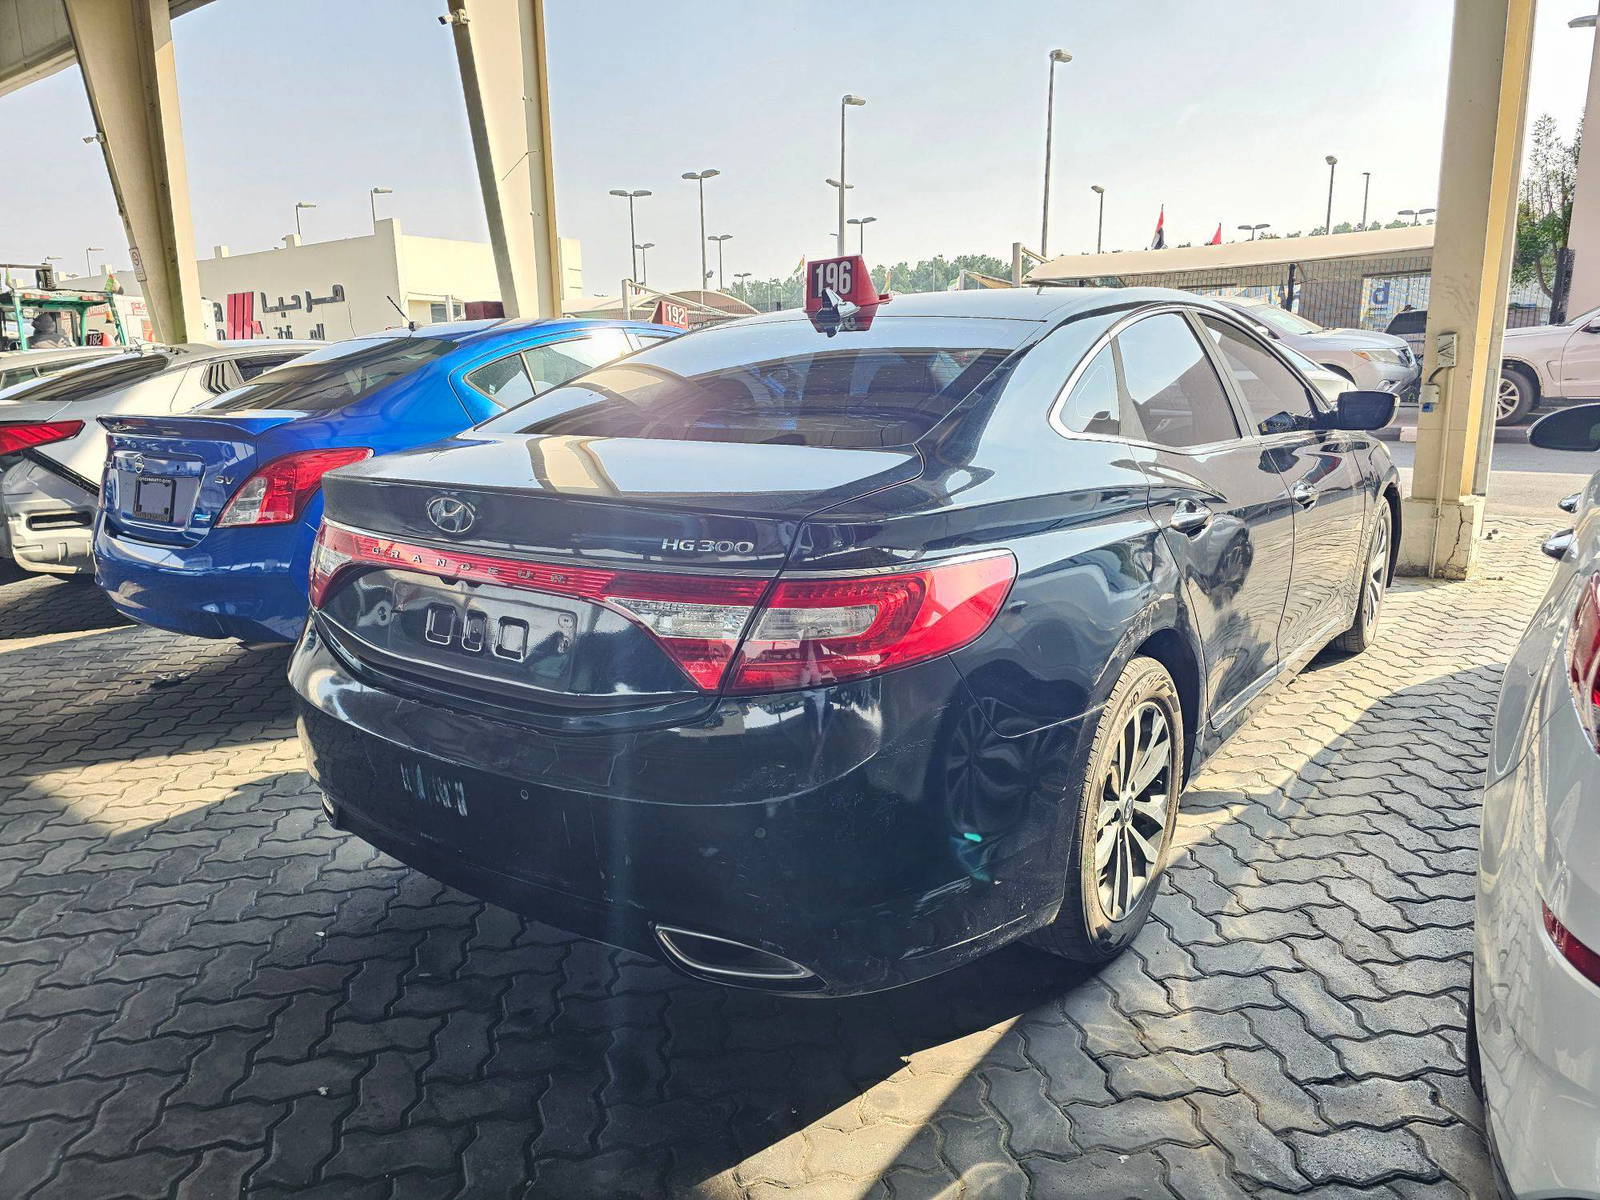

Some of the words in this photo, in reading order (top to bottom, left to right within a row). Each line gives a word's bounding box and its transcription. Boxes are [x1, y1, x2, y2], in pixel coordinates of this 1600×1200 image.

[815, 260, 852, 298] 196
[260, 284, 345, 318] مرحبا
[667, 304, 686, 325] 192
[88, 333, 103, 346] 182
[214, 475, 235, 485] SV
[371, 545, 568, 584] GRANDEUR
